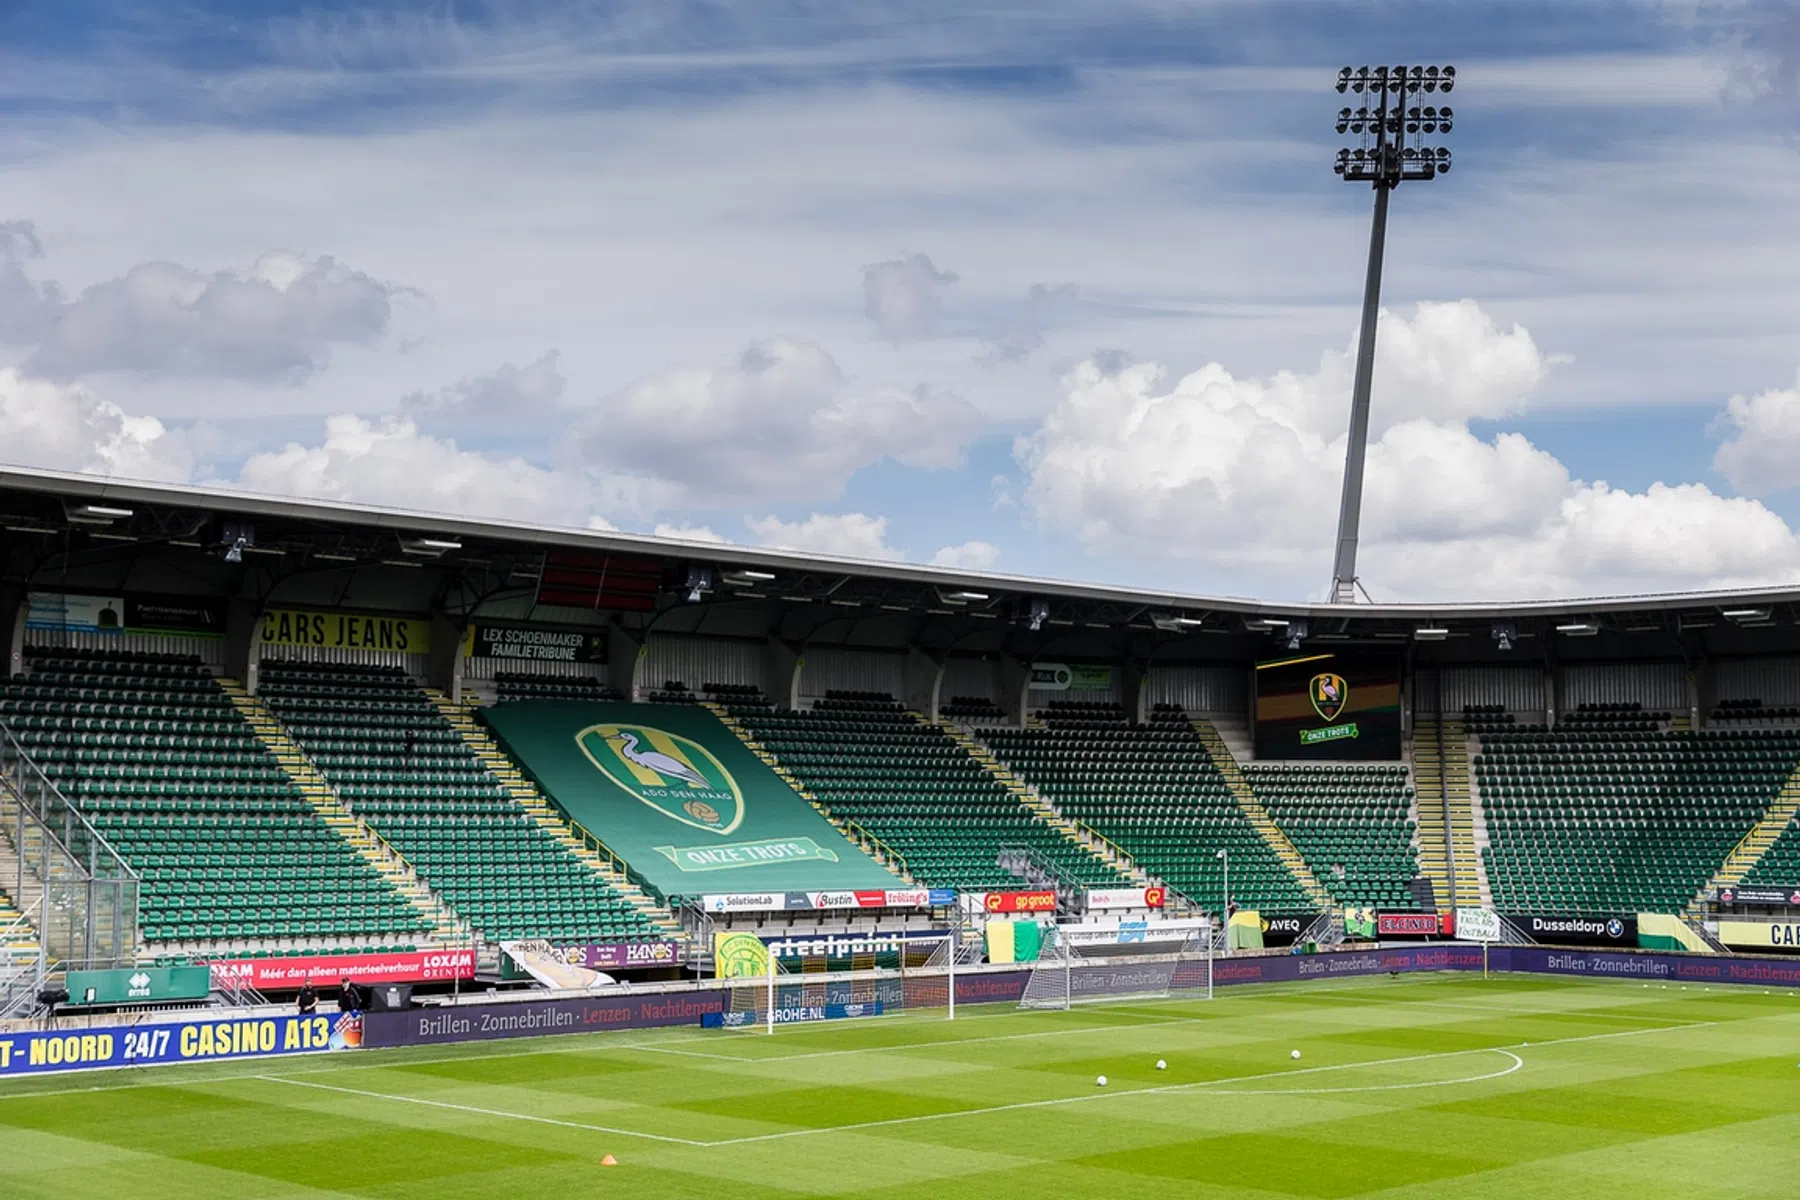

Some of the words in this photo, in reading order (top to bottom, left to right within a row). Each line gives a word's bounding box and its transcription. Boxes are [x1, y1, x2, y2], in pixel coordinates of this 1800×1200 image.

[262, 612, 325, 644] CARS
[335, 615, 408, 650] JEANS
[482, 627, 504, 642] LEX
[504, 629, 584, 648] SCHOENMAKER
[490, 642, 577, 661] FAMILIETRIBUNE
[642, 789, 668, 797] ADO
[669, 789, 697, 799] DEN
[697, 790, 733, 800] HAAG
[687, 848, 744, 865] ONZE
[742, 843, 808, 860] TROTS
[726, 895, 773, 906] SolutionLab
[821, 893, 853, 906] Bustin
[1015, 896, 1028, 909] gp
[1028, 894, 1054, 908] groot
[1270, 919, 1300, 932] AVEQ
[1532, 918, 1605, 934] Dusseldorp
[259, 968, 287, 979] Méér
[287, 967, 307, 978] dan
[307, 966, 337, 977] alleen
[338, 962, 420, 976] materieelverhuur
[423, 954, 472, 968] LOXAM
[1299, 959, 1325, 975] Brillen
[1329, 956, 1378, 973] Zonnebrillen
[1415, 951, 1485, 967] Nachtlenzen
[1548, 956, 1586, 970] Brillen
[1593, 957, 1669, 975] Zonnebrillen
[1677, 963, 1720, 977] Lenzen
[955, 979, 1021, 998] Nachtlenzen
[419, 1015, 470, 1036] Brillen
[480, 1008, 573, 1032] Zonnebrillen
[583, 1006, 631, 1024] Lenzen
[640, 1000, 723, 1020] Nachtlenzen
[29, 1034, 114, 1066] NOORD
[123, 1030, 172, 1059] 24/7
[180, 1021, 277, 1058] CASINO
[284, 1017, 330, 1050] A13
